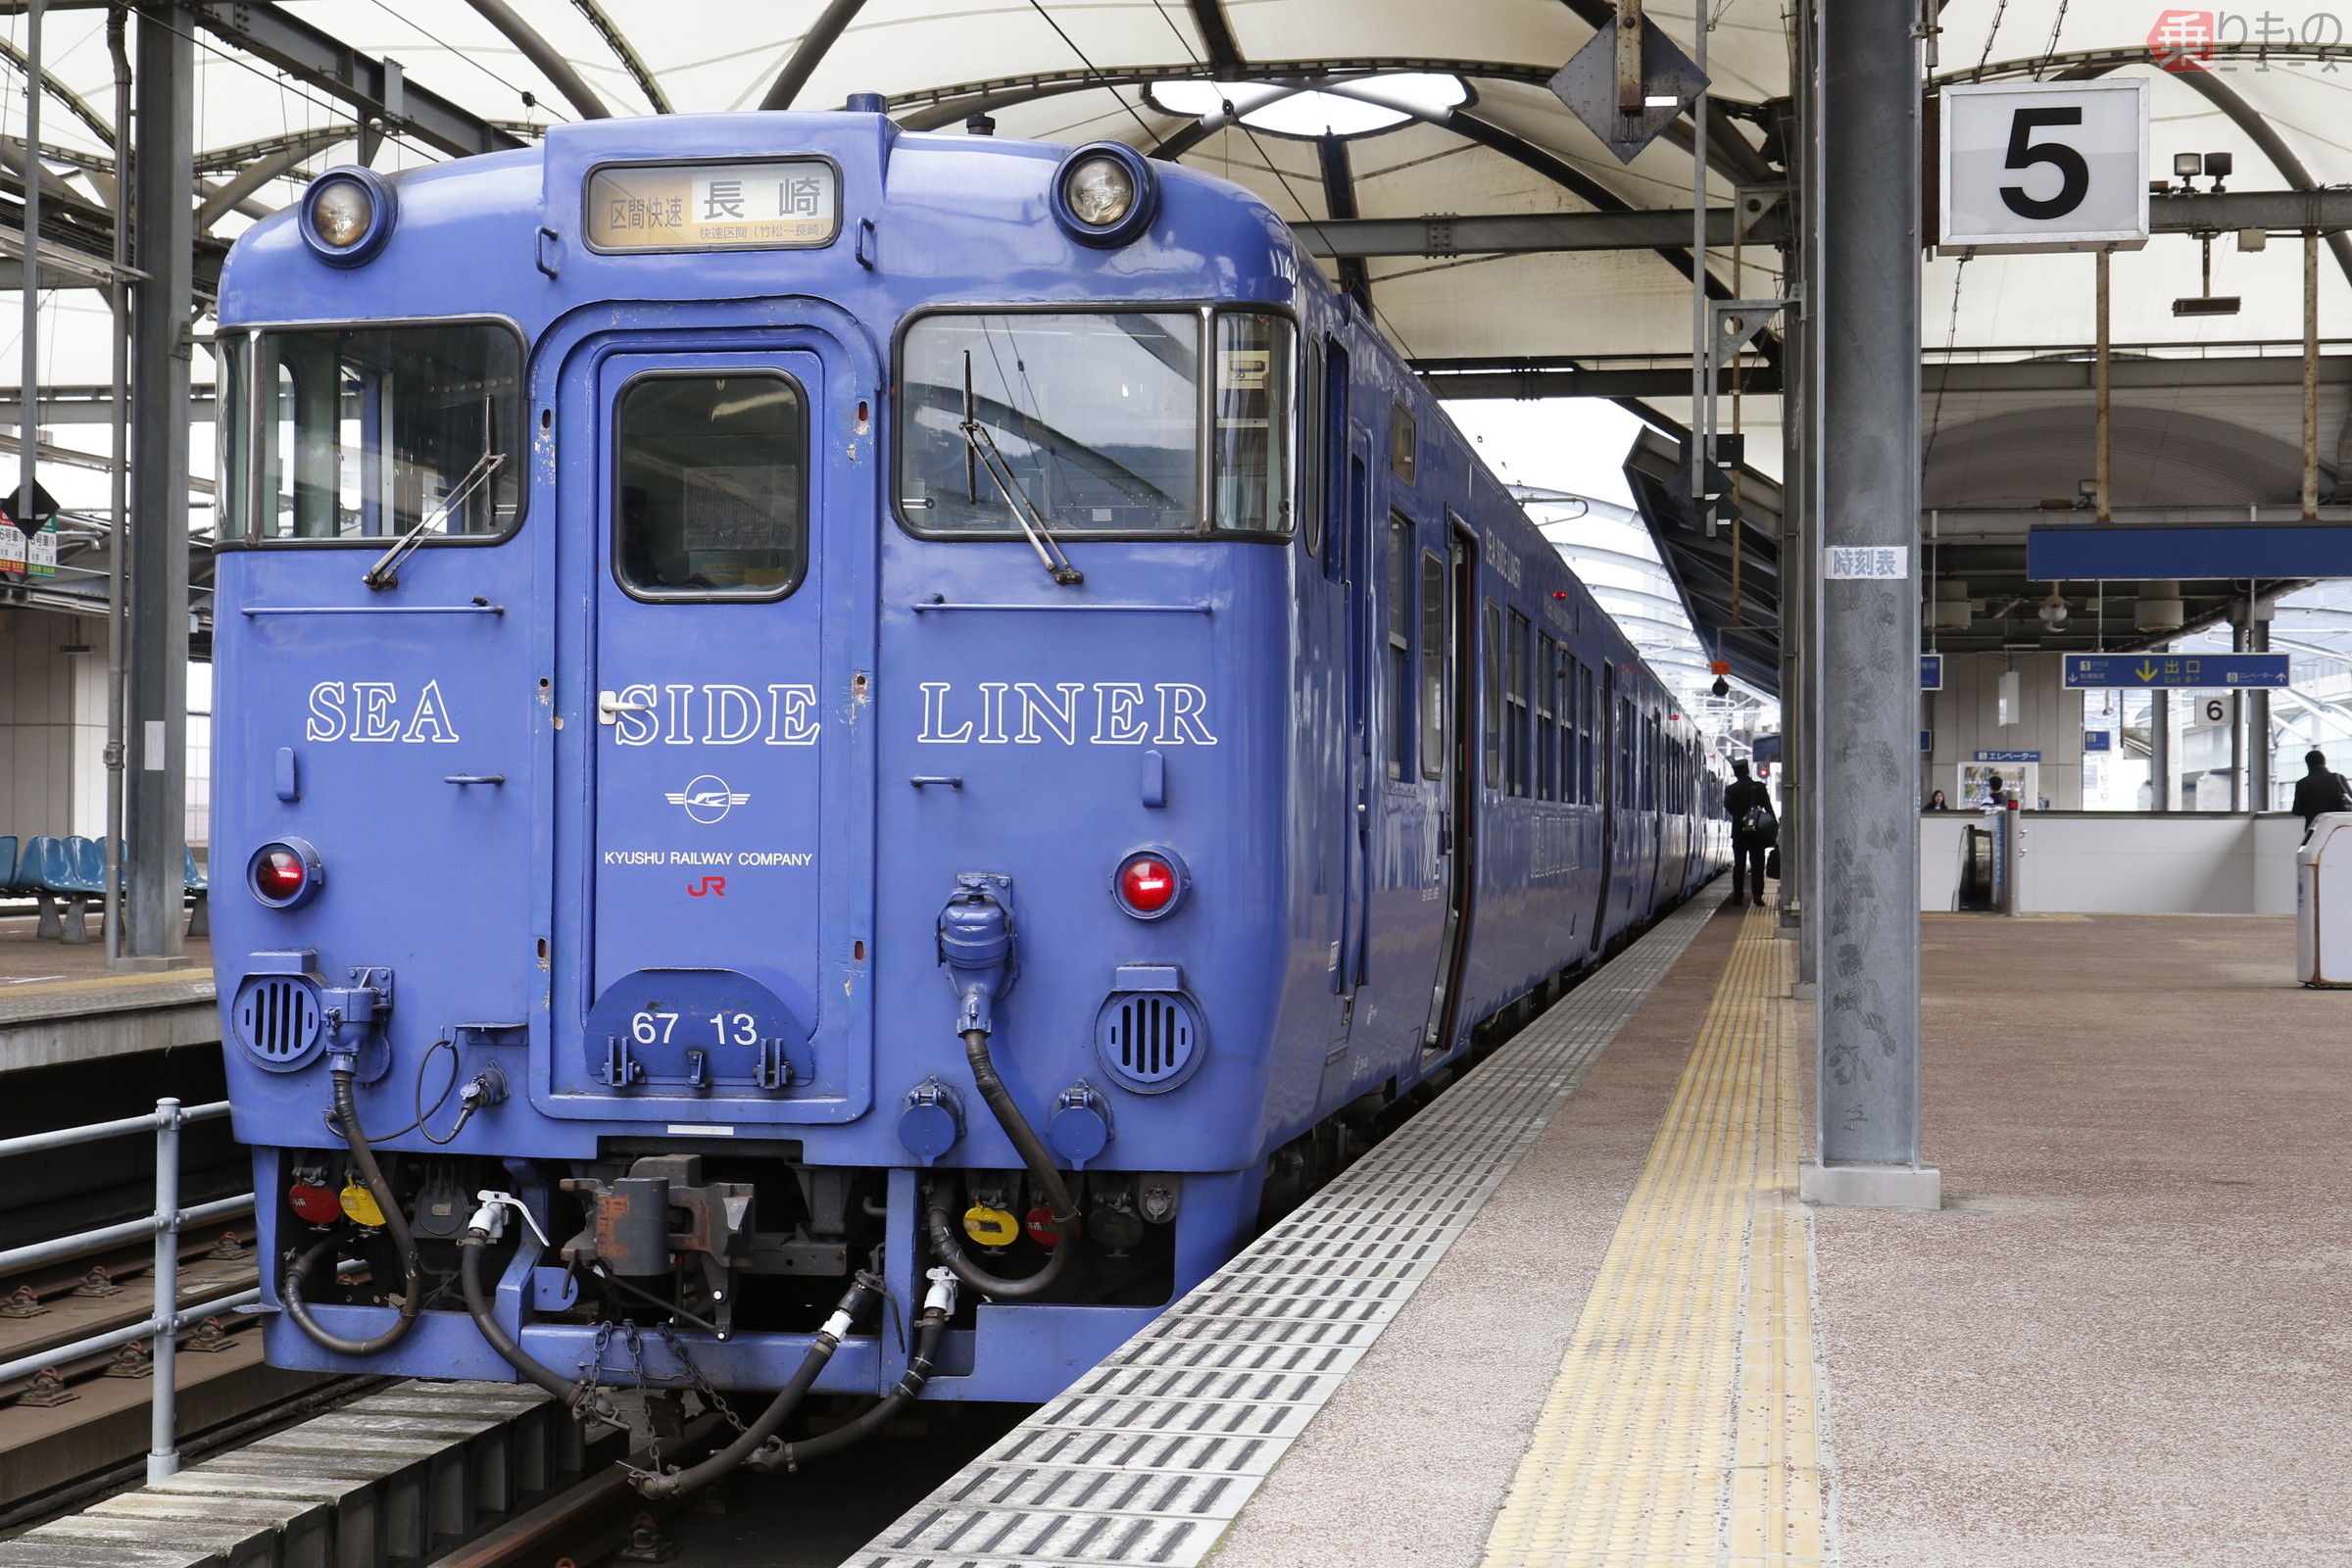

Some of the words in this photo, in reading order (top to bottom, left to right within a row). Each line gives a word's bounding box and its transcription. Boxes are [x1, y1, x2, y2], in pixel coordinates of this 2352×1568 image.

[1999, 106, 2089, 220] 5
[704, 176, 821, 220] 長崎
[610, 197, 683, 231] 区間快速
[1834, 548, 1896, 576] 時刻表
[2165, 660, 2200, 674] 出口
[307, 679, 460, 743] SEA
[615, 684, 821, 746] SIDE
[917, 682, 1218, 745] LINER
[2207, 700, 2224, 721] 6
[1988, 752, 2038, 760] エレベーター
[605, 852, 664, 864] KYUSHU
[669, 852, 733, 865] RAILWAY
[738, 853, 812, 866] COMPANY
[687, 876, 726, 897] JR
[632, 1012, 679, 1045] 67
[710, 1013, 758, 1046] 13
